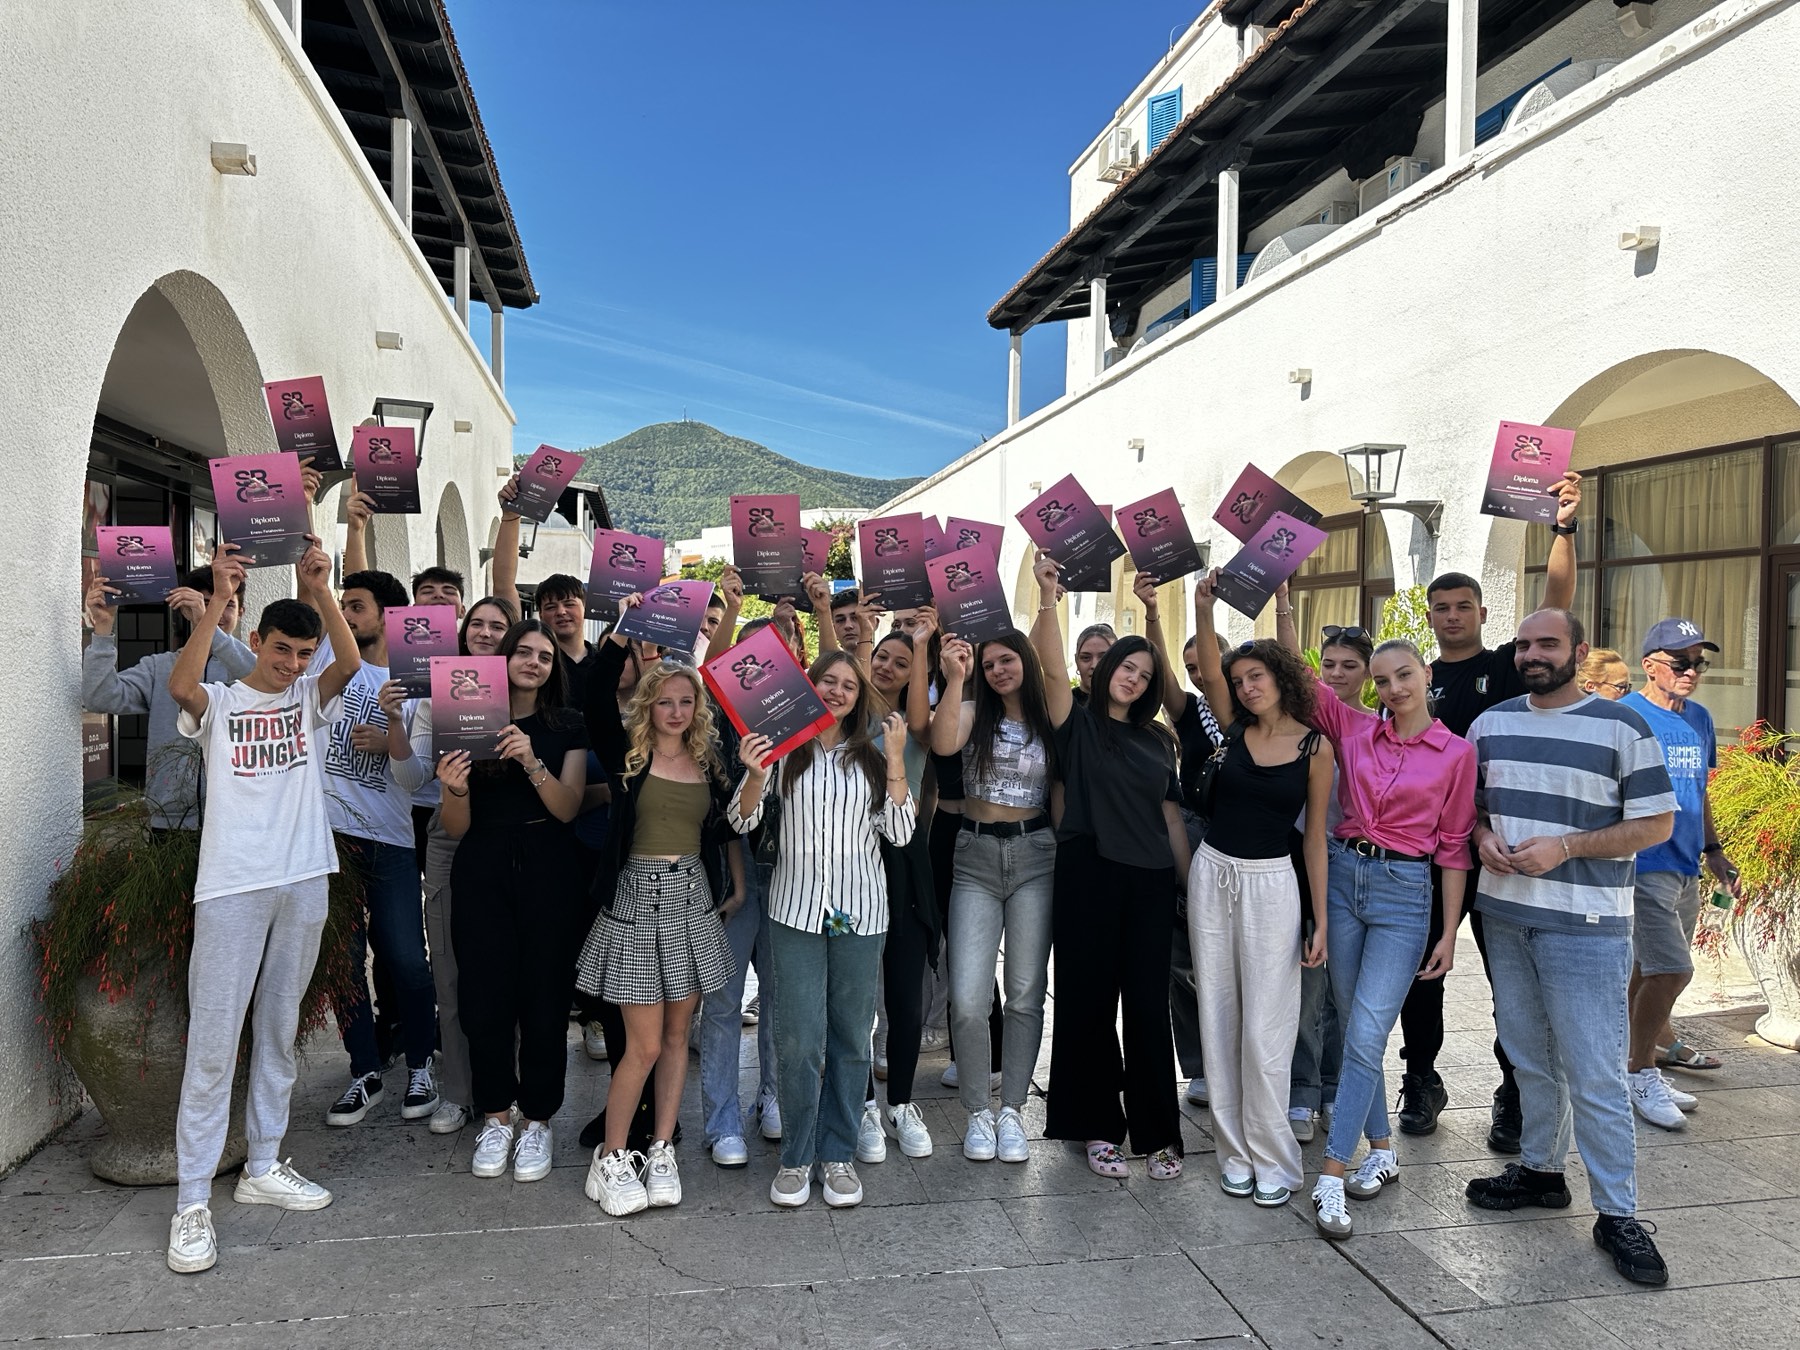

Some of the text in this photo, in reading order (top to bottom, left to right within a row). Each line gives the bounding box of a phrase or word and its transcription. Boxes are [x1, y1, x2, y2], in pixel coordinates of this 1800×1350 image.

[1514, 475, 1538, 483] Diploma
[251, 516, 280, 525] Diploma
[1064, 530, 1086, 545] Diploma
[1152, 541, 1172, 553] Diploma
[613, 580, 636, 589] Diploma
[960, 599, 983, 609] Diploma
[652, 613, 676, 621] Diploma
[761, 689, 784, 706] Diploma
[229, 711, 302, 742] HIDDEN
[231, 733, 308, 769] JUNGLE
[1668, 746, 1701, 757] SUMMER
[1668, 757, 1702, 768] SUMMER
